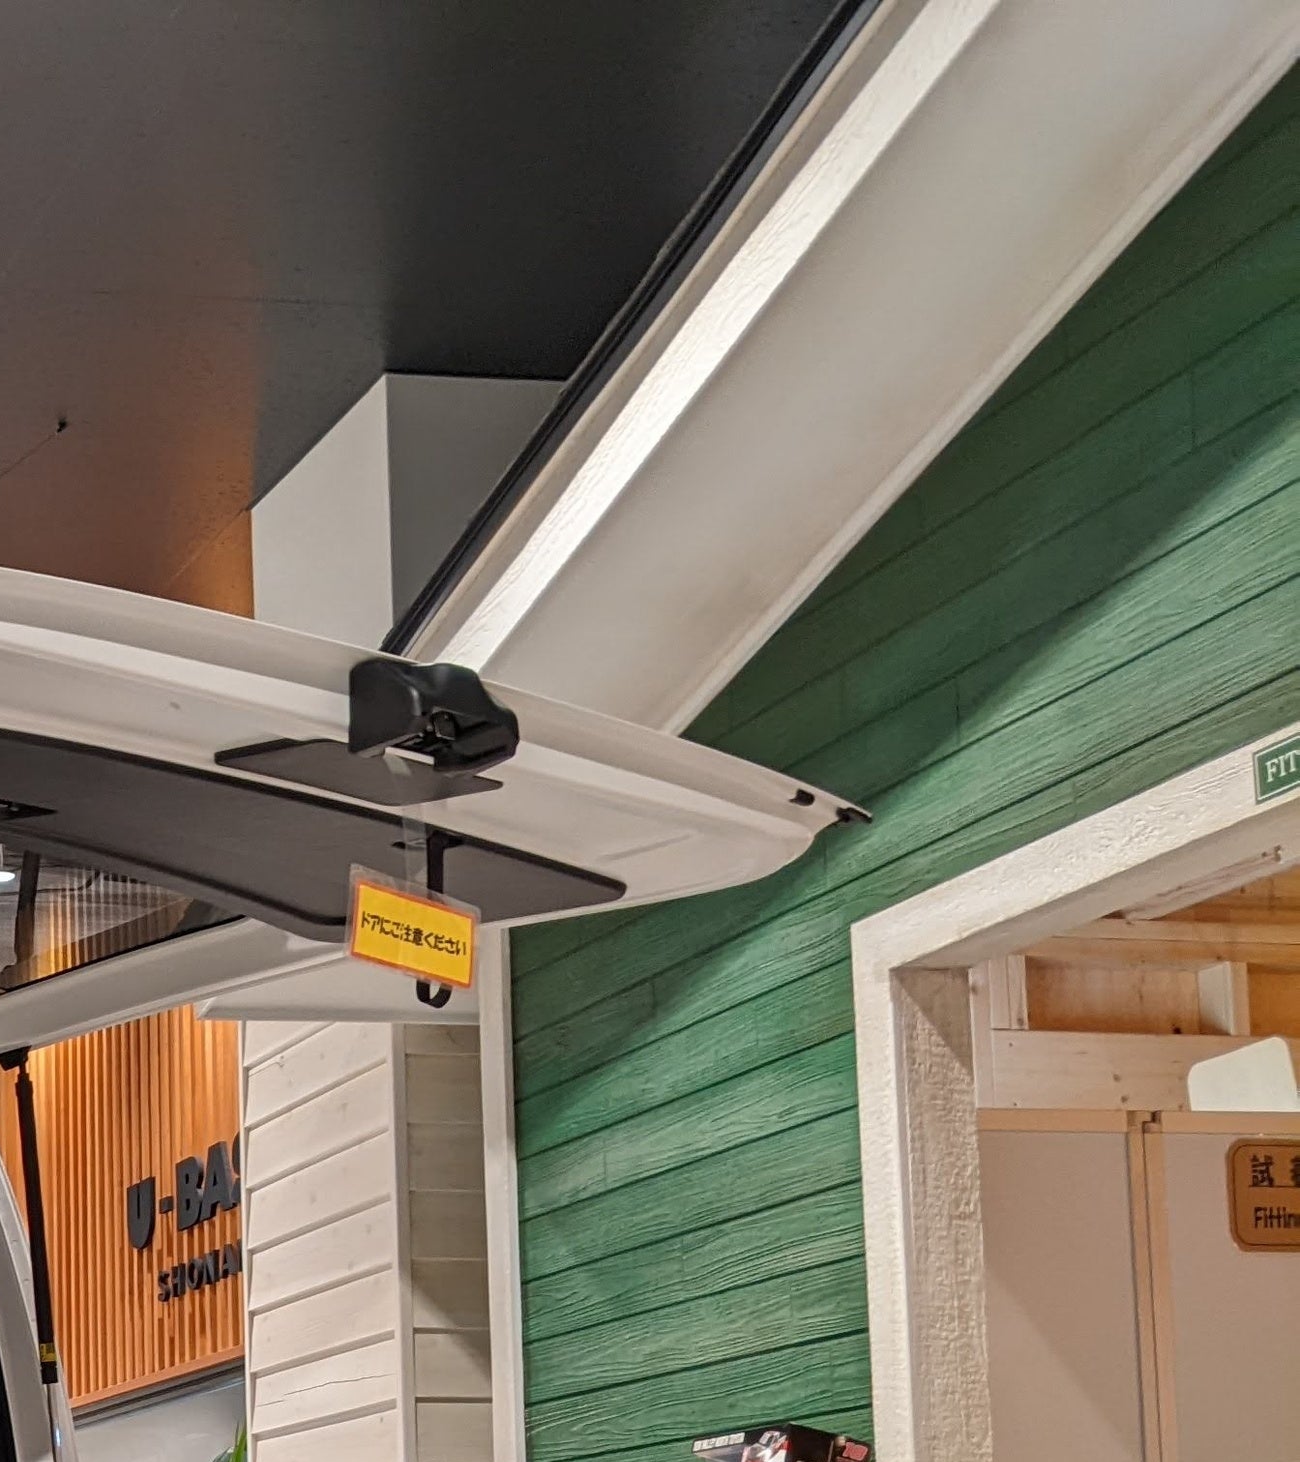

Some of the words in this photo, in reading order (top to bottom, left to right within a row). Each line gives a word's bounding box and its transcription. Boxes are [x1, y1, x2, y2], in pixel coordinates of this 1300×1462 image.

[361, 911, 467, 955] ドアにご注意ください
[158, 1238, 243, 1302] SHONA
